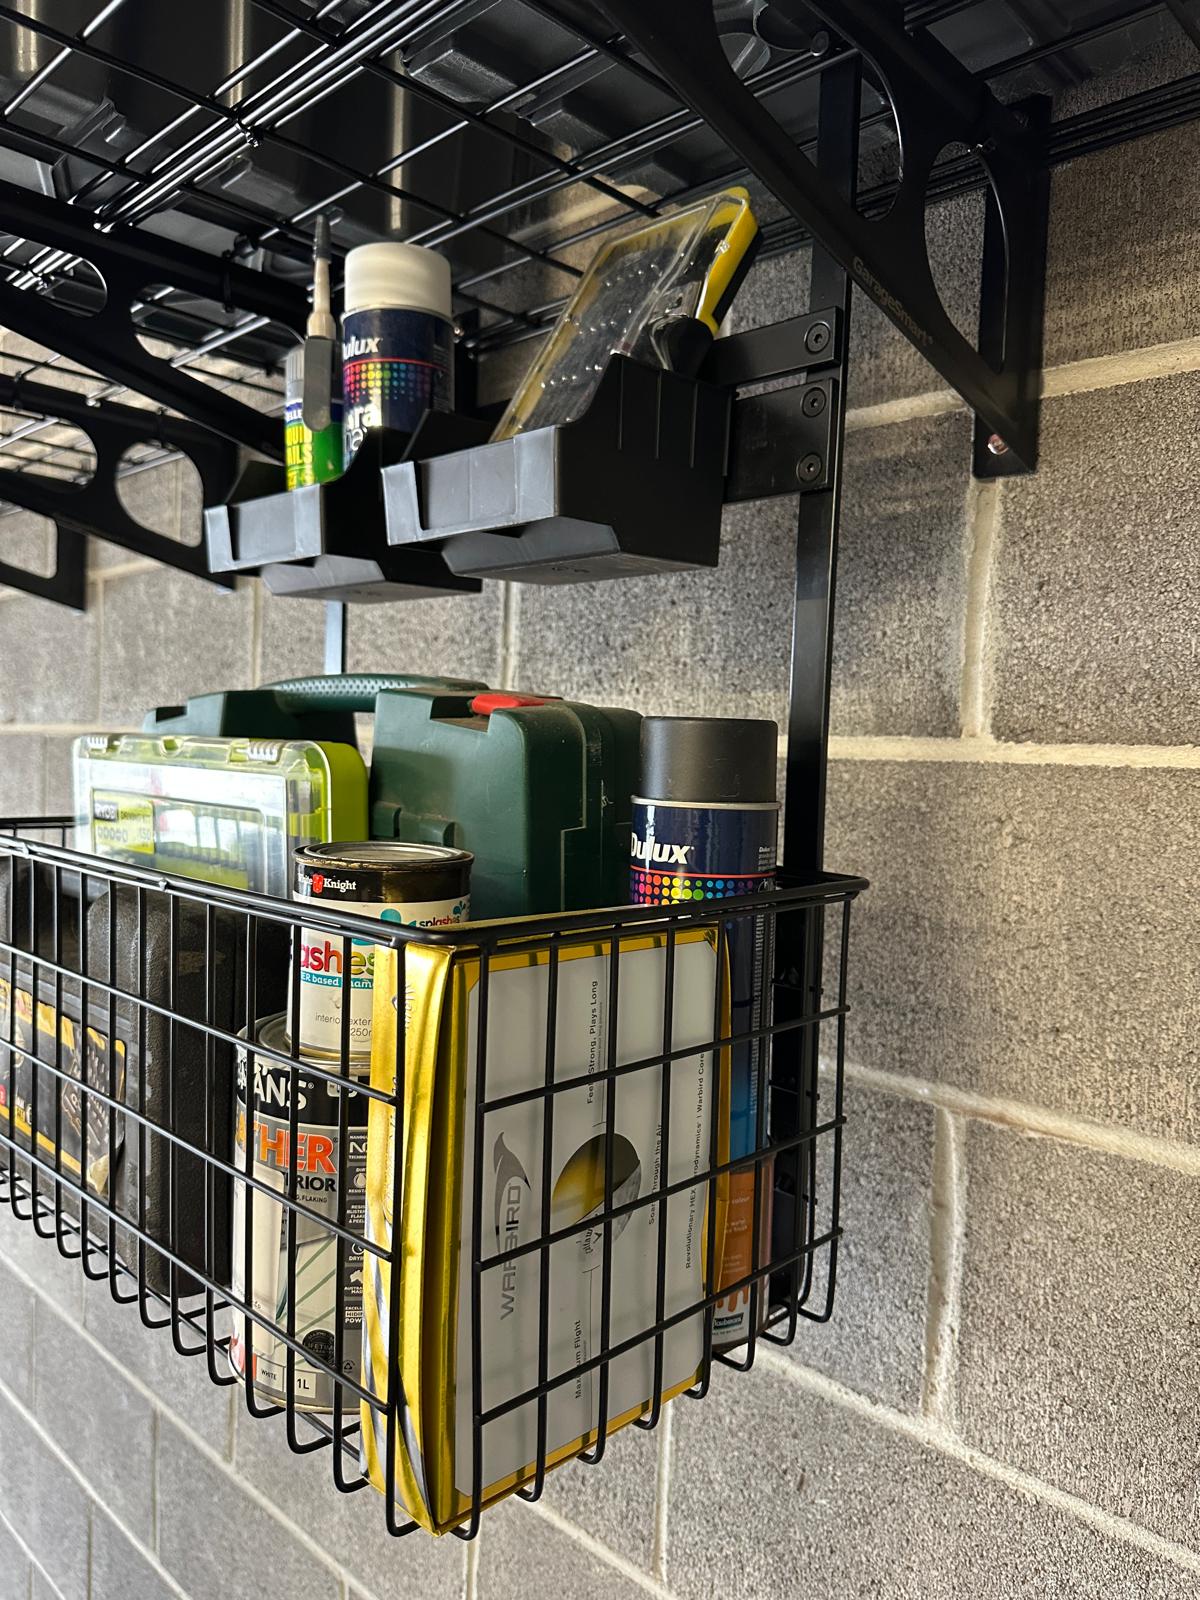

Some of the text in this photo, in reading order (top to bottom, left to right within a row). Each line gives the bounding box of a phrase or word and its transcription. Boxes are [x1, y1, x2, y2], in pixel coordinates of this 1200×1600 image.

[631, 832, 691, 864] Dulux
[323, 878, 357, 893] Knight
[312, 974, 339, 986] based
[315, 1012, 341, 1025] interio
[590, 1005, 598, 1035] Plays
[698, 1054, 706, 1075] Core
[696, 1078, 705, 1113] Warbird
[689, 1188, 697, 1208] HEX
[648, 1203, 656, 1225] Soar
[685, 1209, 696, 1269] Revolutionary
[574, 1319, 582, 1349] Flight
[261, 1368, 277, 1381] WHITE
[297, 1378, 310, 1390] 1L
